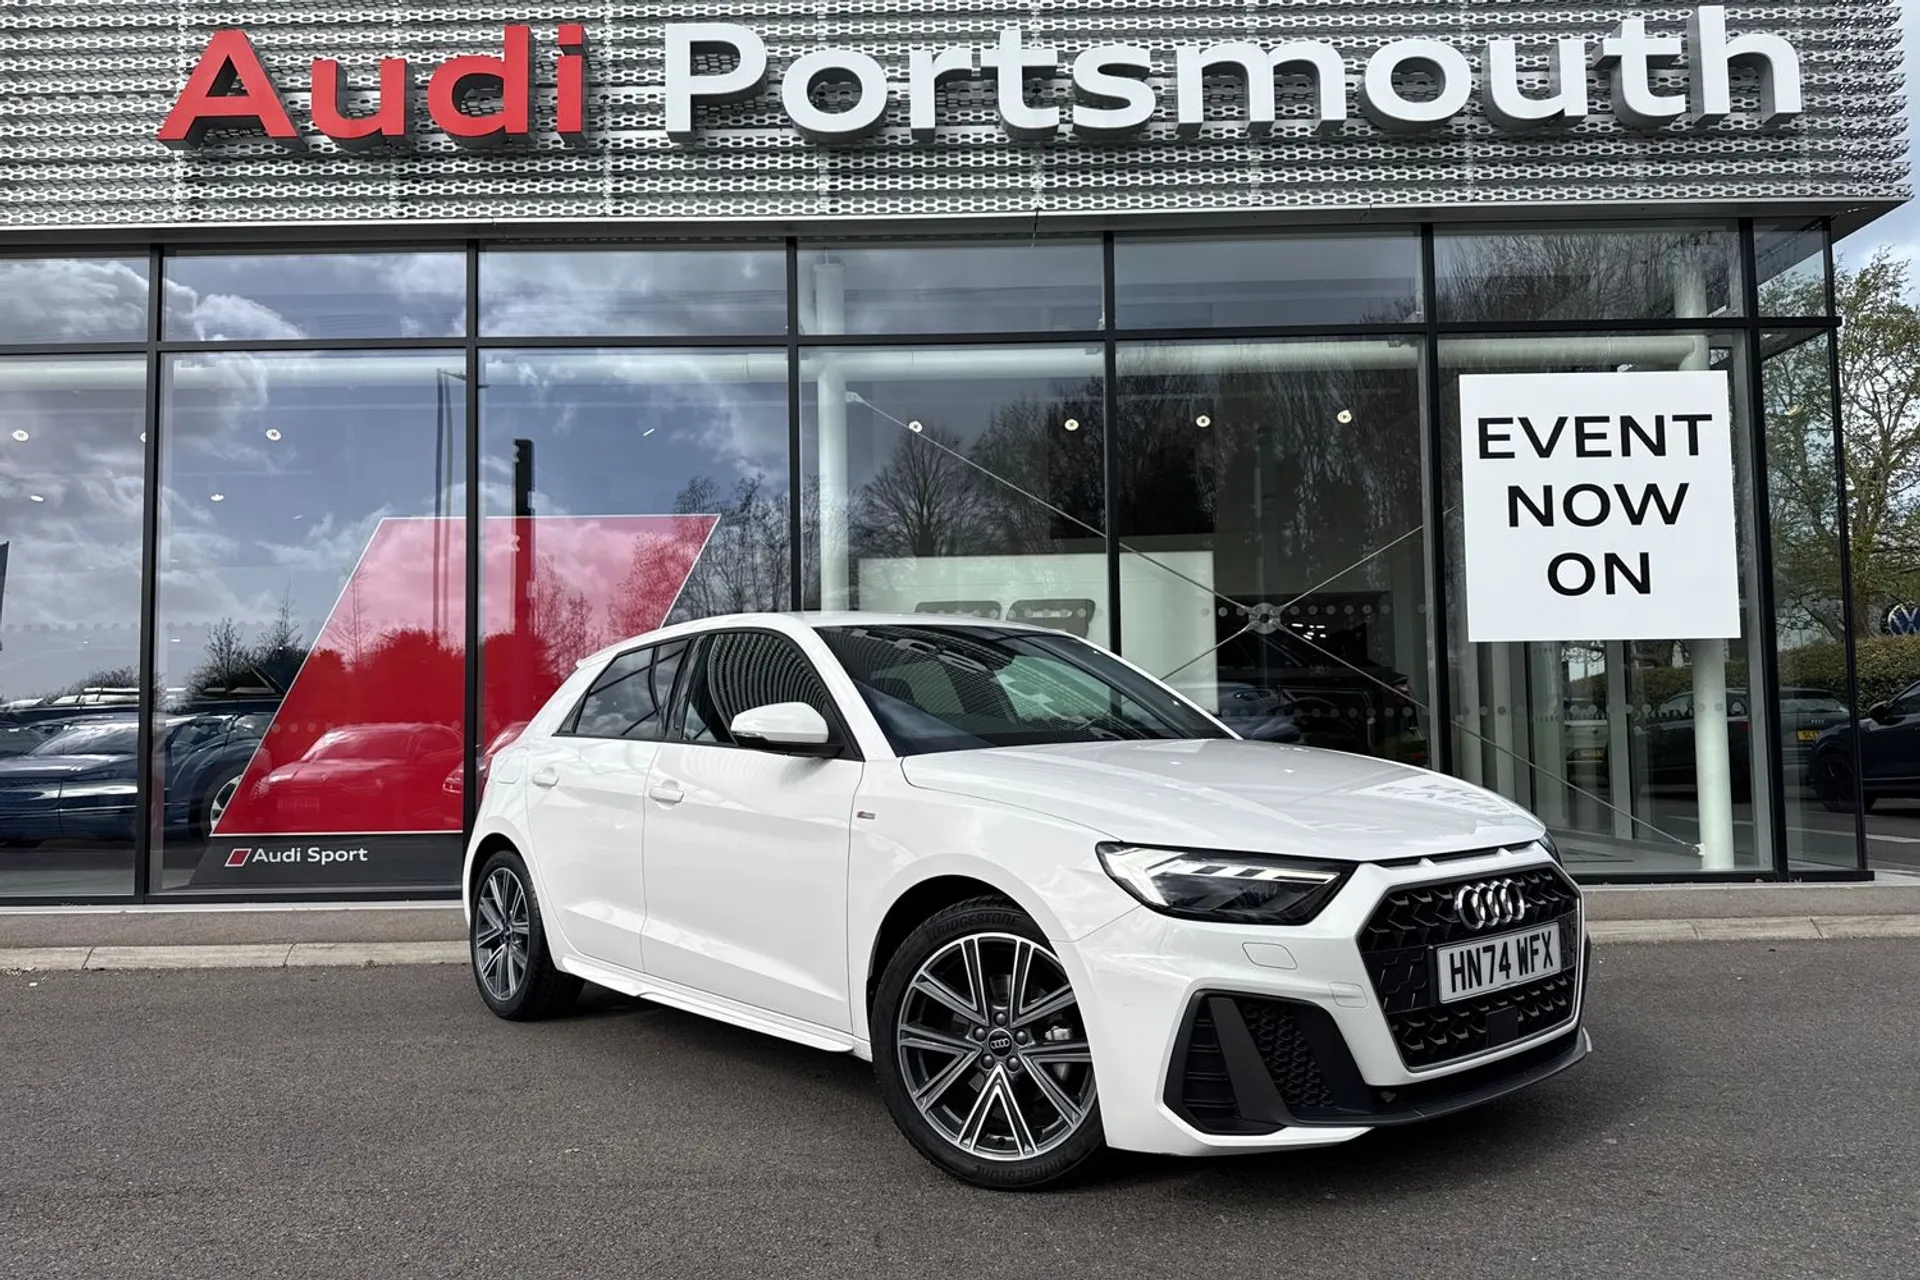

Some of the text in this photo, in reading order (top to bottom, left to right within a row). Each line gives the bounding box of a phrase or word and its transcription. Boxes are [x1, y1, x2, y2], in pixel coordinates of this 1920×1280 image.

[156, 5, 1802, 144] Audi Portsmouth
[1477, 413, 1713, 460] EVENT
[1507, 482, 1690, 528] NOW
[1546, 551, 1651, 597] ON
[252, 846, 369, 866] Audi Sport
[1449, 930, 1554, 994] HN74 WFX
